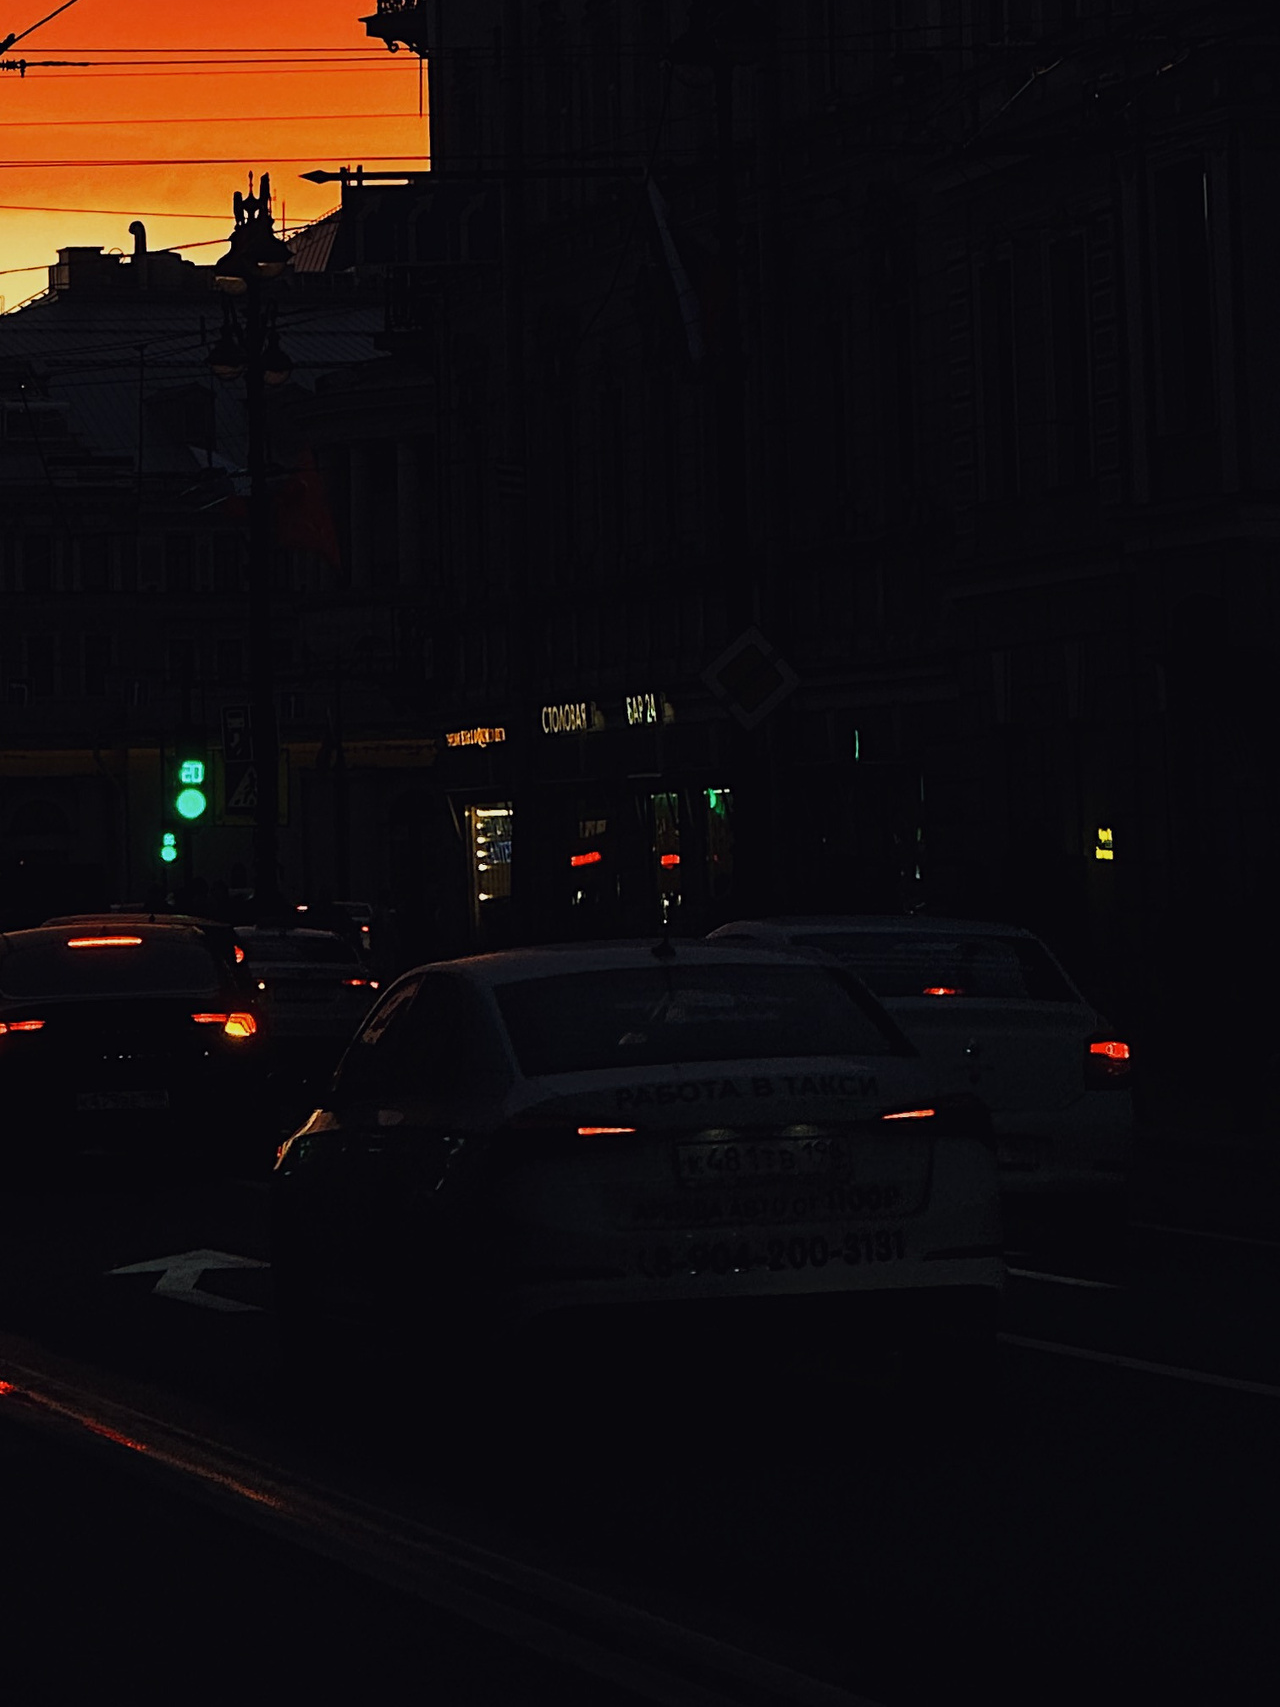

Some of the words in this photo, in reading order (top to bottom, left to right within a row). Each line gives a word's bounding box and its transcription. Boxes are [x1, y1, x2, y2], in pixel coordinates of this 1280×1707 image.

[542, 702, 587, 734] СТОЛОВАЯ
[626, 694, 643, 725] БАР
[645, 693, 657, 723] 24
[180, 761, 204, 784] 20
[615, 1079, 741, 1111] РАБОТА
[751, 1076, 774, 1098] В
[783, 1075, 879, 1097] ТАКСИ
